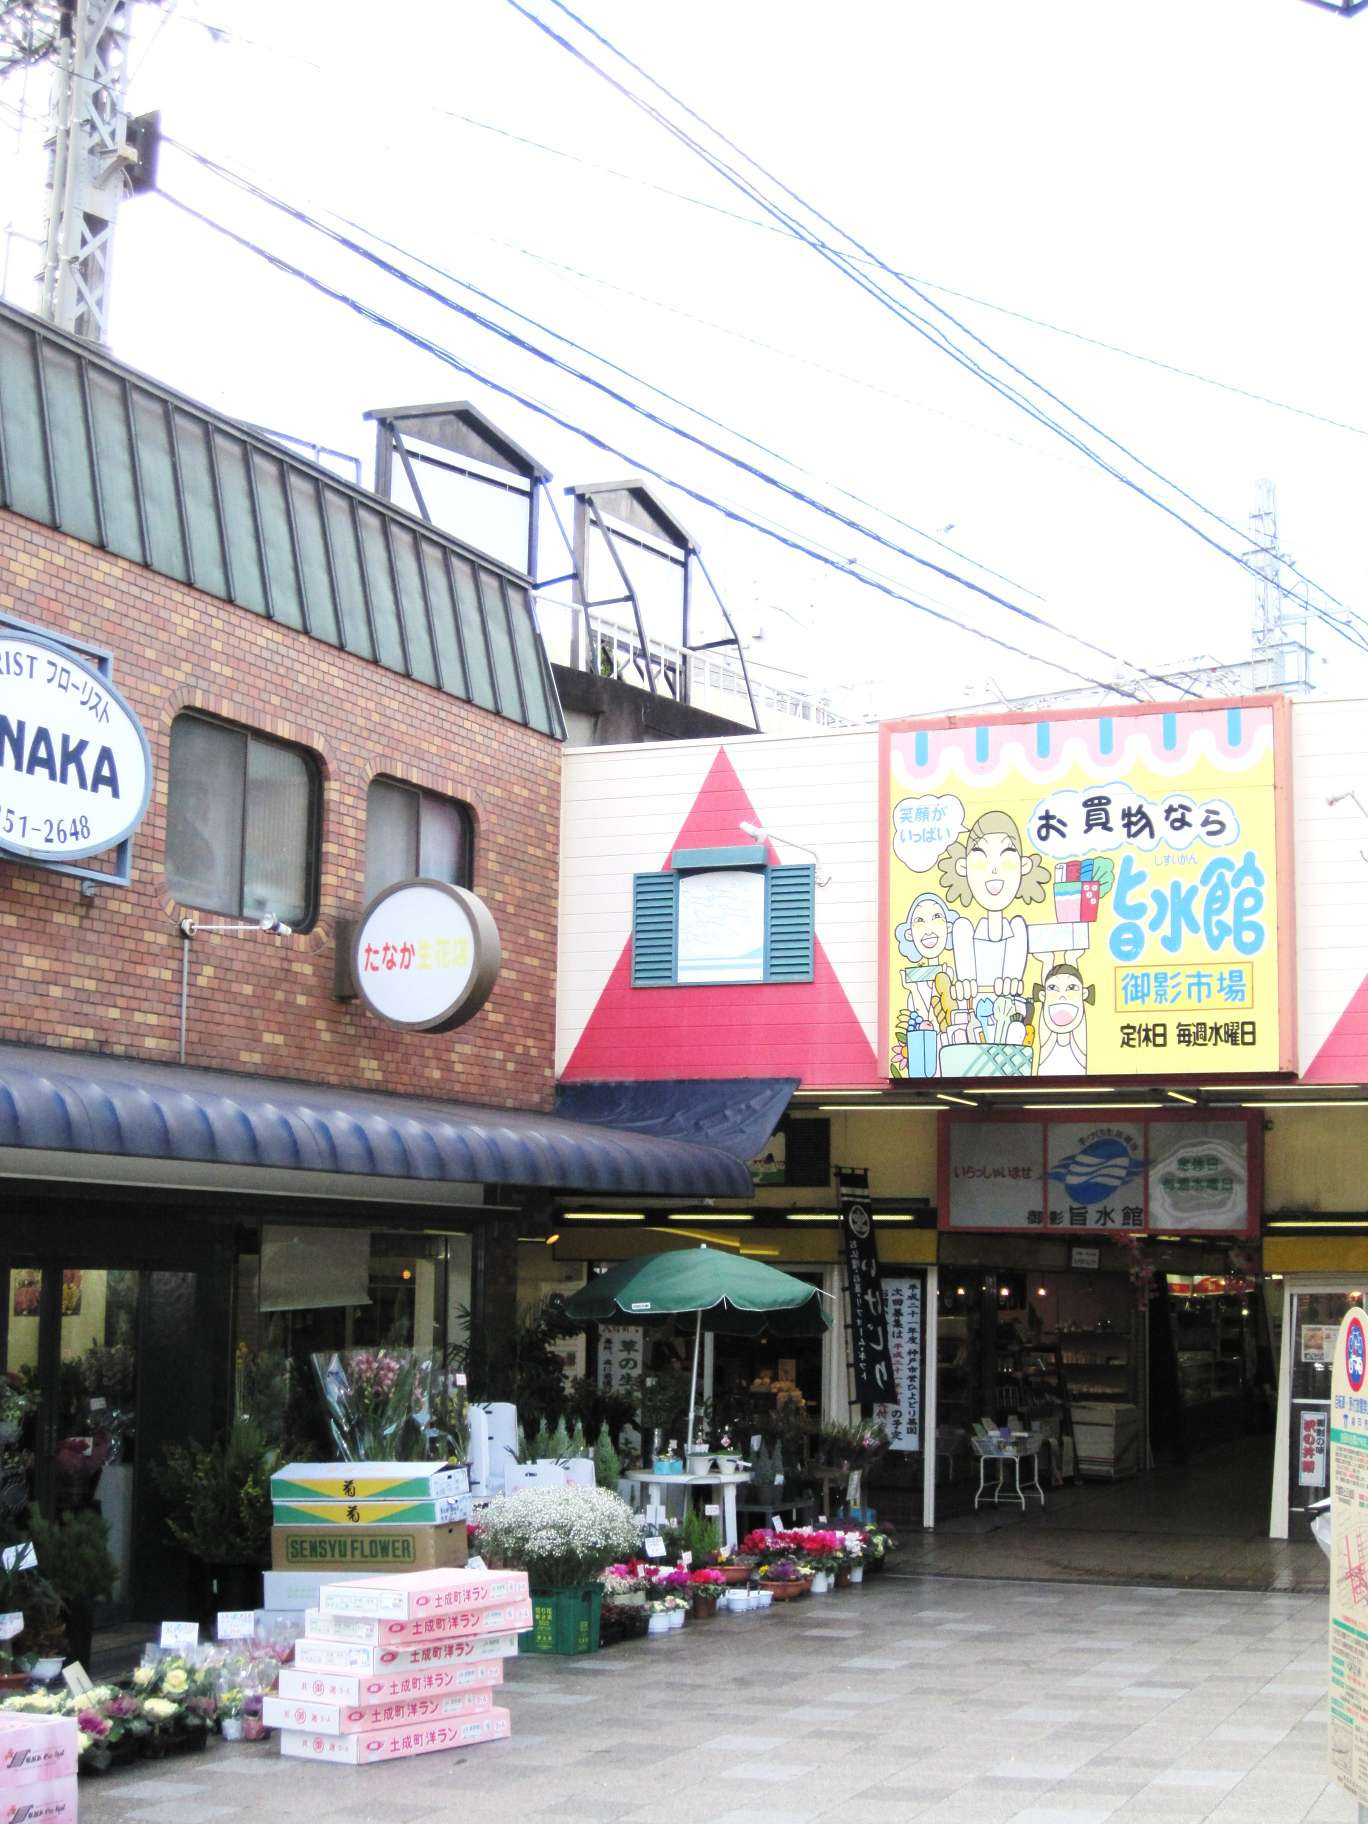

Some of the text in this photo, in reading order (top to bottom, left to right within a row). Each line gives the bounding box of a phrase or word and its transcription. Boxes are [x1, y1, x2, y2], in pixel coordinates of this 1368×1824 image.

[47, 660, 110, 723] フローリスト
[0, 807, 91, 844] 51-2648
[900, 806, 946, 823] 笑顔が
[1037, 796, 1226, 840] お買物なら
[900, 828, 950, 843] いっぱい
[1109, 851, 1265, 961] 旨水館
[1121, 969, 1246, 1005] 御影市場
[1120, 1021, 1256, 1048] 定休日 毎週水曜日
[954, 1166, 1032, 1180] いらっしゃいませ
[290, 1538, 411, 1560] SENSYU FLOWER
[435, 1586, 488, 1608] 土成町洋ラン
[412, 1612, 480, 1635] 土成町洋ラン
[409, 1642, 474, 1663] 土成町洋ラン
[390, 1672, 453, 1695] 土成町洋ラン
[371, 1701, 439, 1723] 土成町洋ラン
[390, 1728, 457, 1752] 土成町洋ラン
